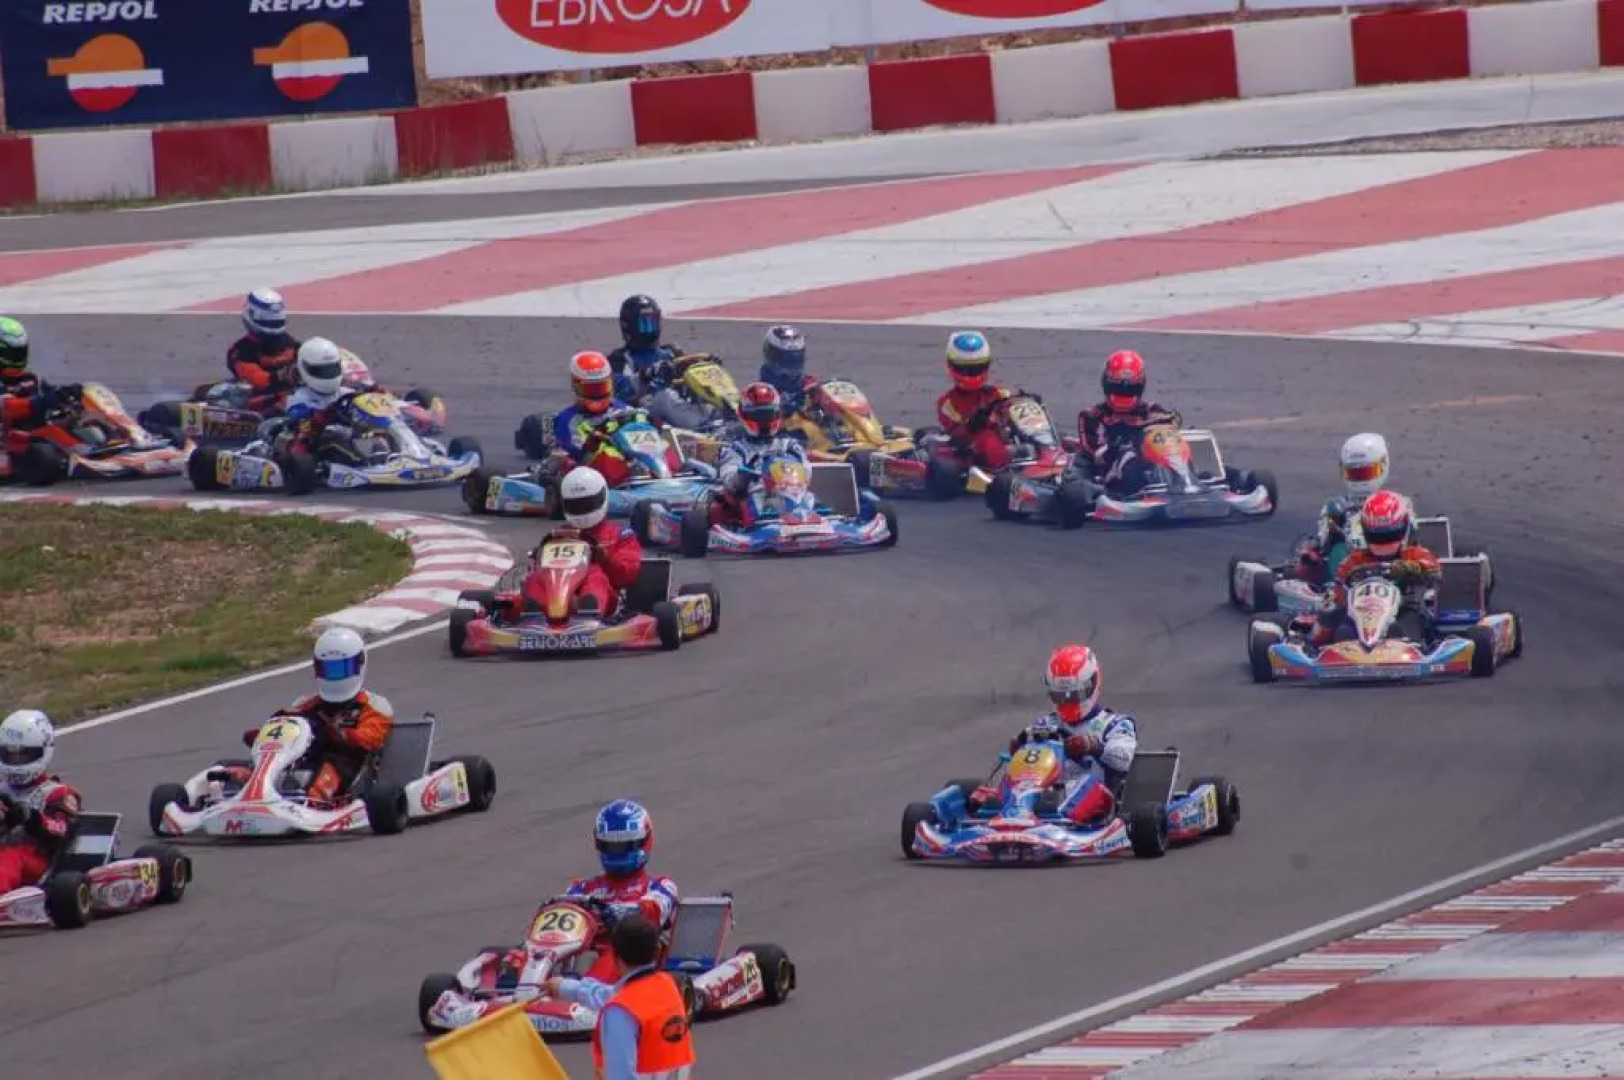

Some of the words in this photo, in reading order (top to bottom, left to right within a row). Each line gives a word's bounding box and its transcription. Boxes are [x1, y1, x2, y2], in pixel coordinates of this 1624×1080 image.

[43, 1, 158, 24] REPSOL
[549, 546, 575, 558] 15
[266, 725, 283, 739] 4
[1023, 749, 1040, 764] 8
[541, 912, 577, 931] 26
